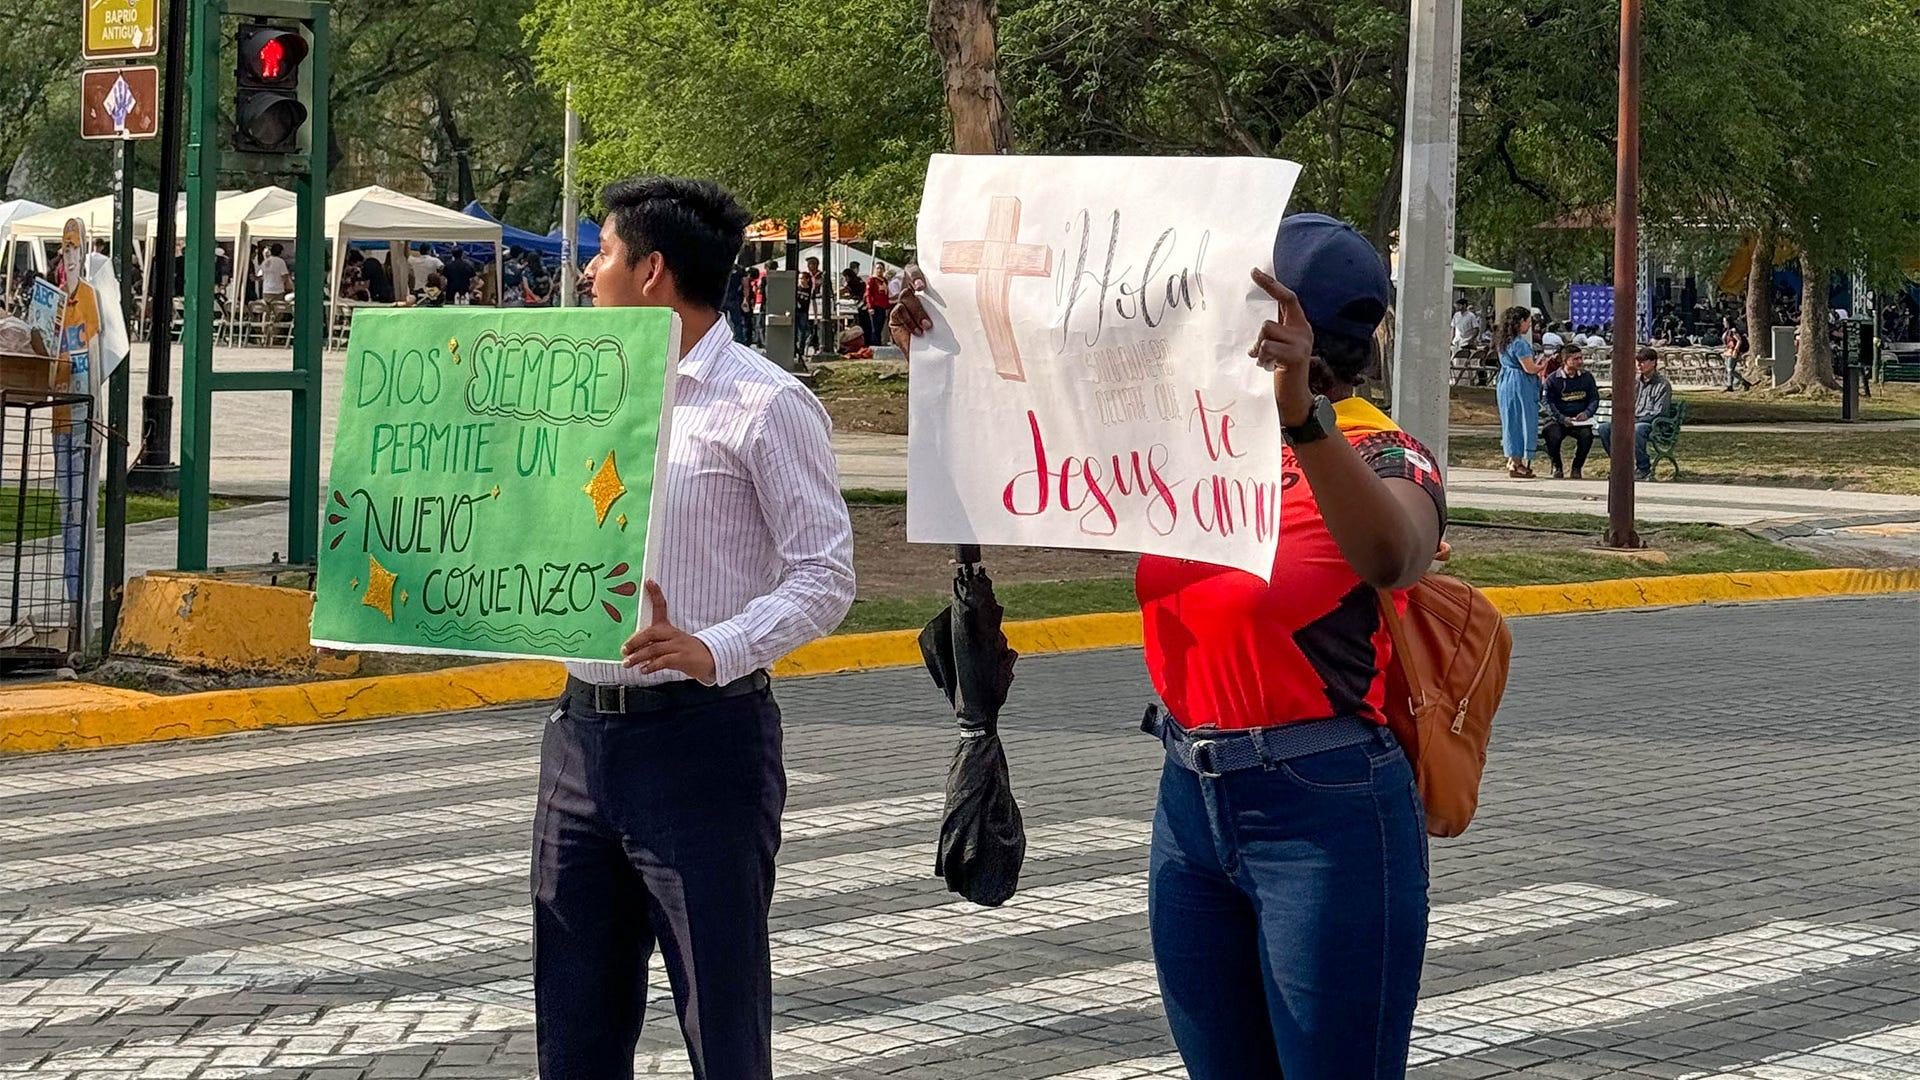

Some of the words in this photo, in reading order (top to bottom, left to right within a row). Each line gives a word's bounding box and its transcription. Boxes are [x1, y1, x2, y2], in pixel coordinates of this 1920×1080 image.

[105, 9, 138, 24] BARRIO
[34, 284, 54, 308] ABC
[358, 348, 441, 408] DIOS
[471, 346, 618, 414] SIEMPRE
[370, 422, 496, 475] PERMITE
[516, 426, 559, 477] UN
[1188, 389, 1248, 462] te
[351, 488, 492, 554] NUEVO
[422, 562, 605, 616] COMIENZO
